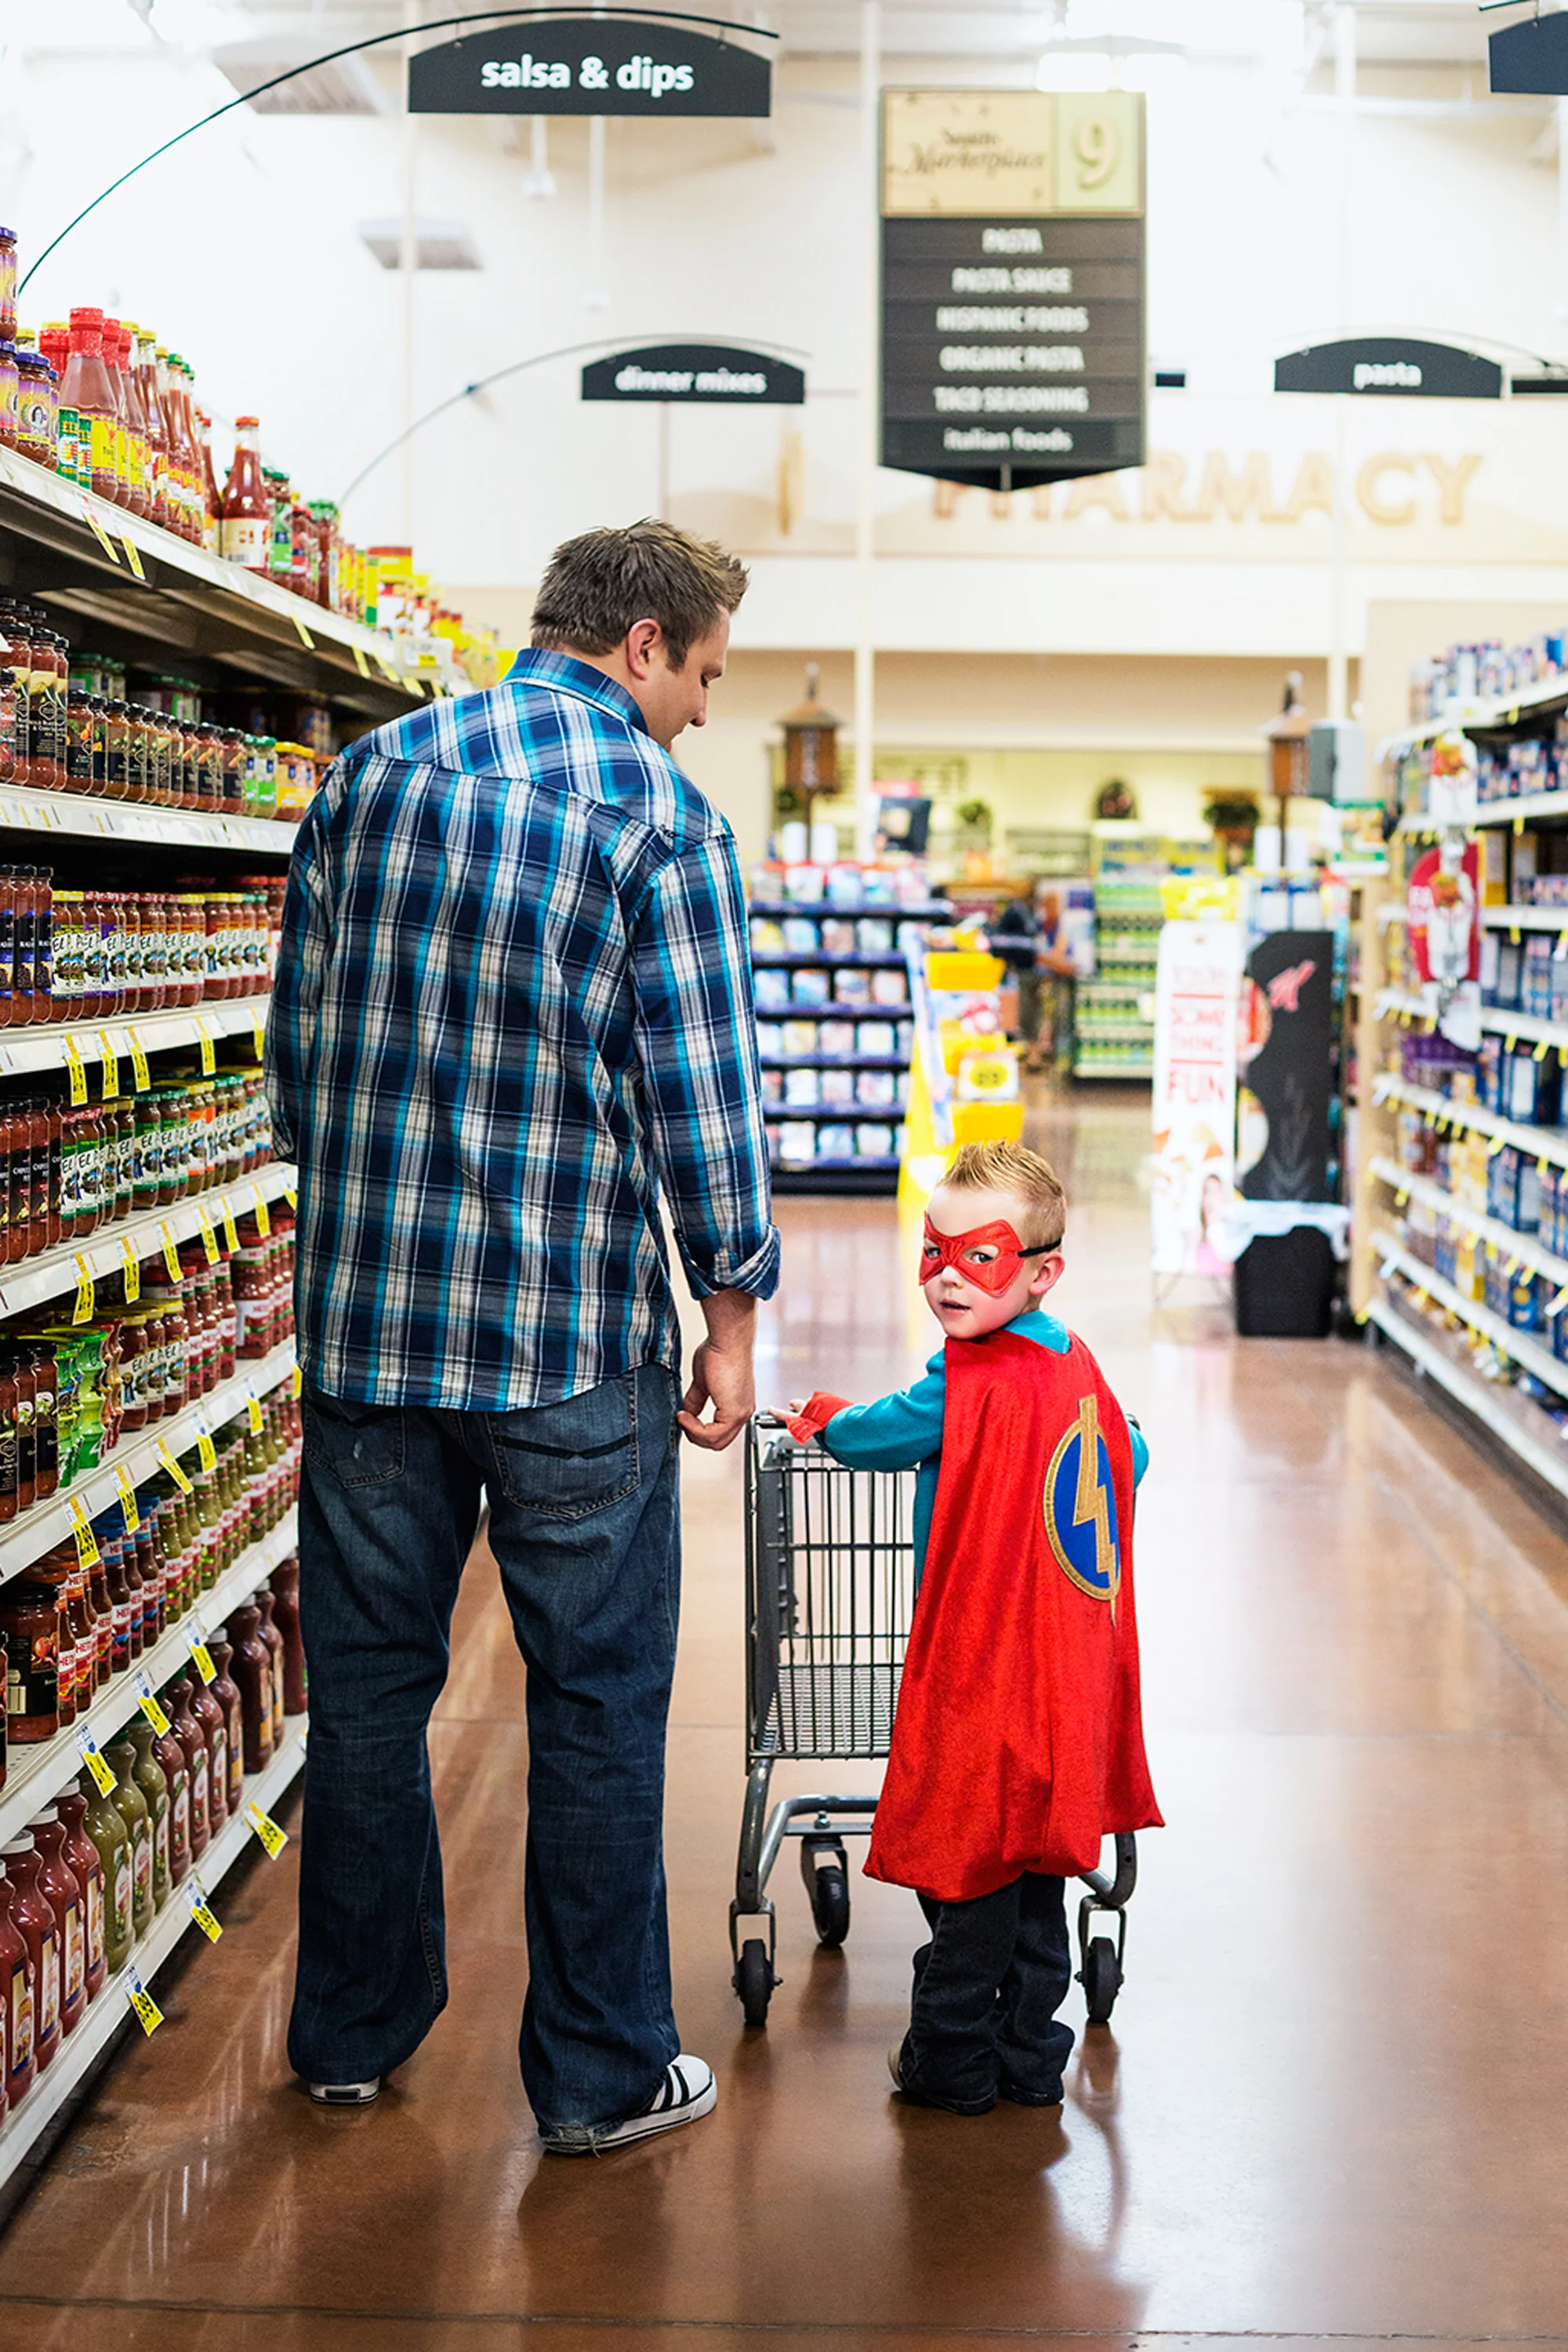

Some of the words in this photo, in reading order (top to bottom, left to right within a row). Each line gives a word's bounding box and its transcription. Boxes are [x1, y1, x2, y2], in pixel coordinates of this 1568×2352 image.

[481, 53, 571, 88] salsa
[579, 56, 609, 89] &
[616, 55, 695, 98] dips
[1074, 119, 1122, 190] 9
[982, 228, 1043, 253] PASTA
[952, 267, 1012, 292] PASTA
[1012, 267, 1073, 292] SAUCE
[936, 307, 1025, 332] HISPANIC
[1025, 307, 1089, 332] FOODS
[939, 346, 1024, 371] ORGANIC
[1025, 346, 1084, 371] PASTA
[615, 365, 694, 391] dinner
[695, 366, 768, 394] mixes
[1353, 361, 1422, 390] pasta
[933, 387, 982, 412] TACO
[982, 386, 1089, 412] SEASONING
[1011, 426, 1073, 452] foods
